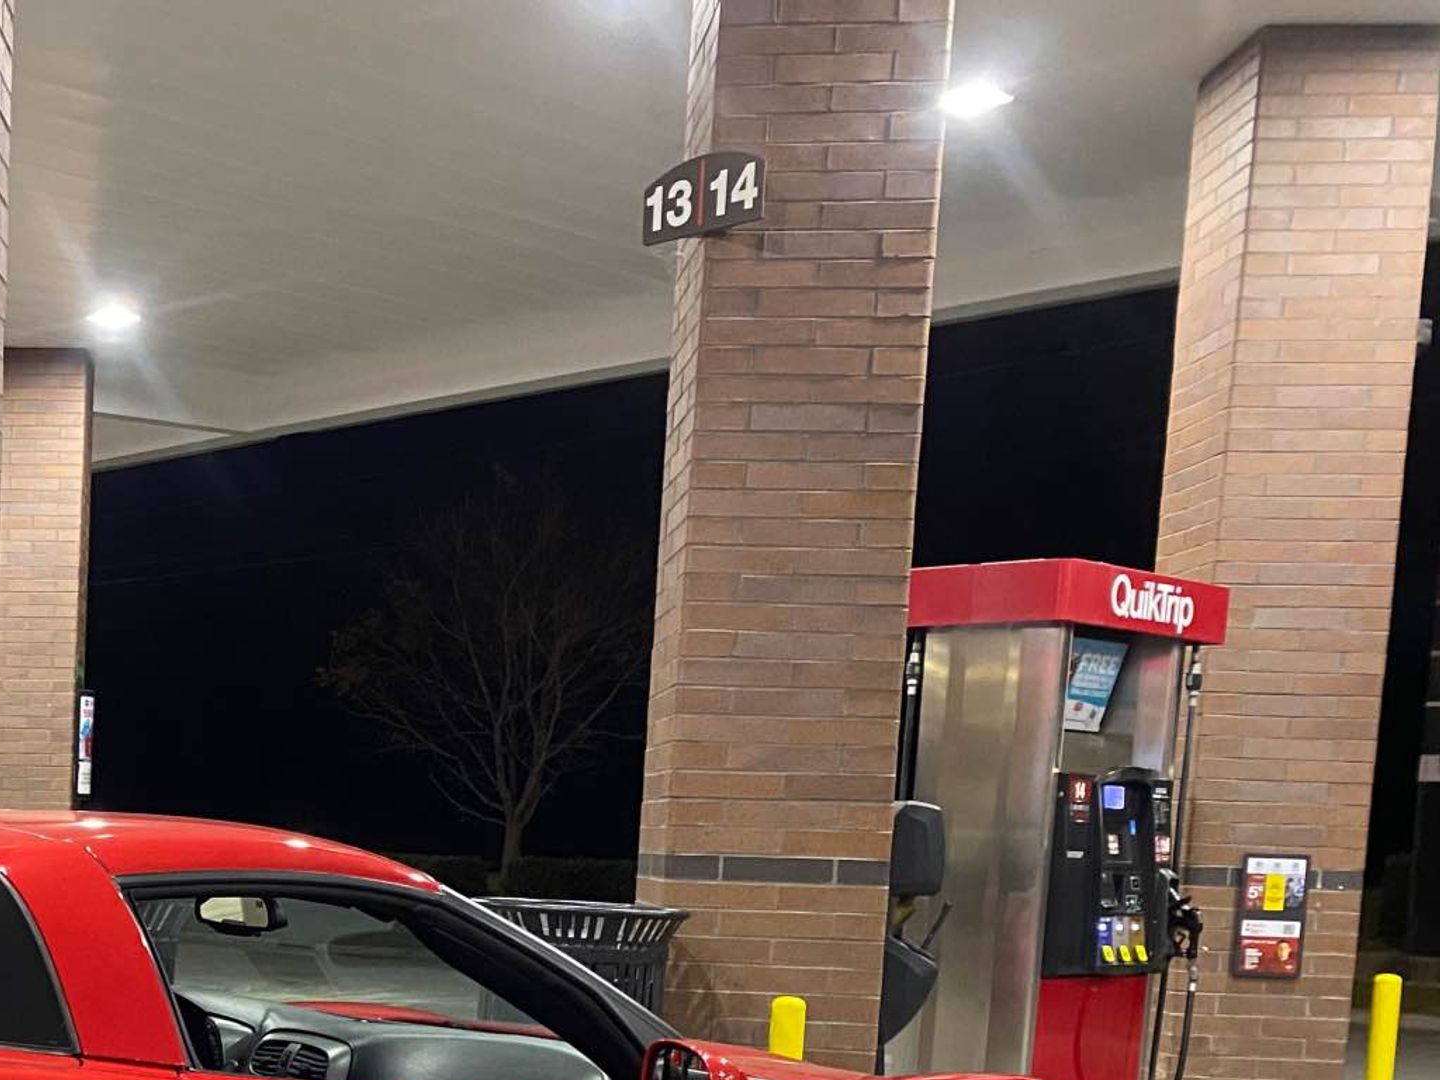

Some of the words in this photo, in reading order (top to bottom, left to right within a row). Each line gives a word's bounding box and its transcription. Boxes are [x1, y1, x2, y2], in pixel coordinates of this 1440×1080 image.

[646, 179, 693, 232] 13
[709, 161, 759, 217] 14
[1111, 573, 1194, 634] QuikTrip
